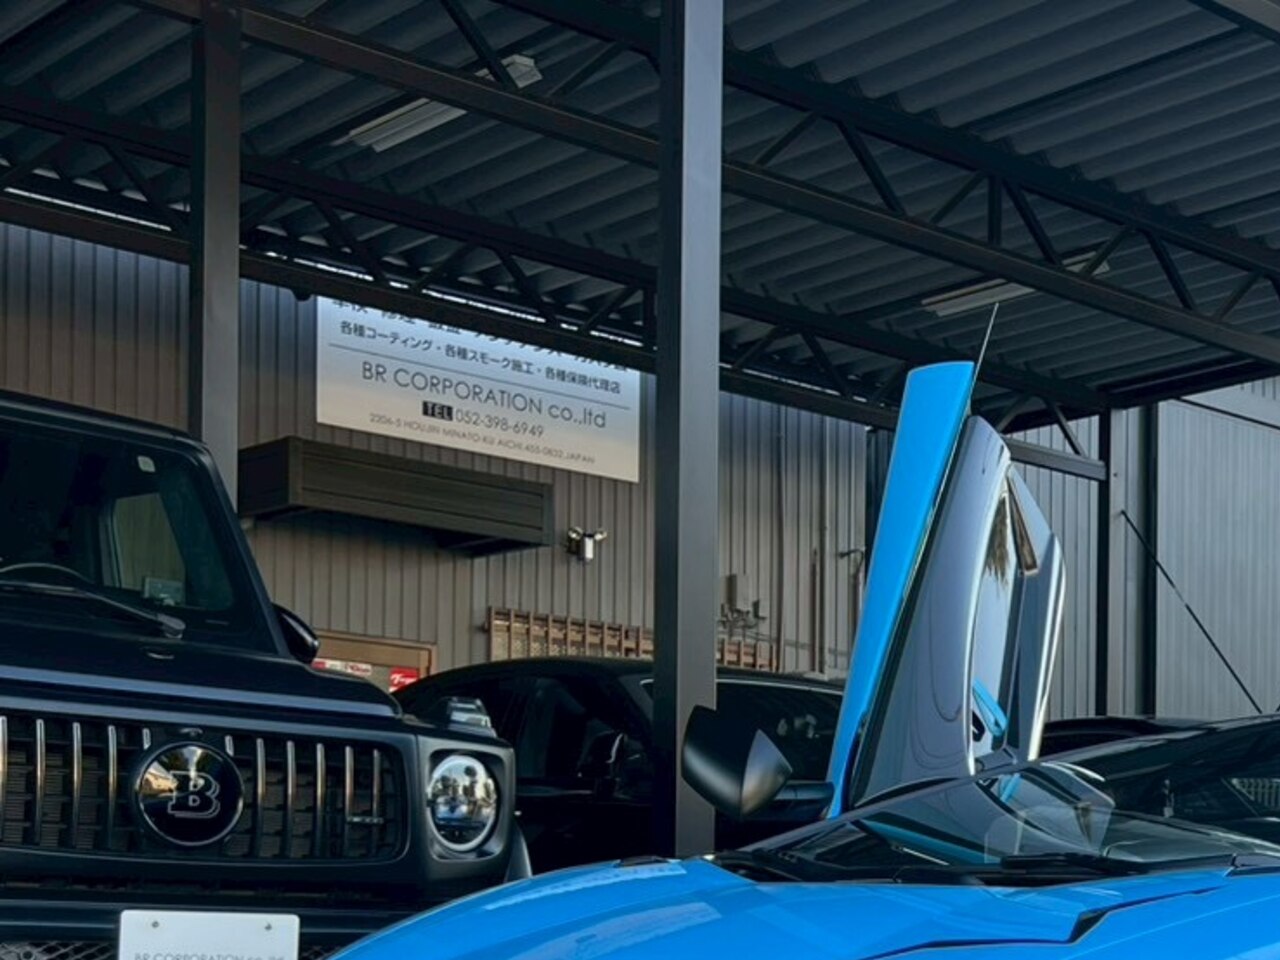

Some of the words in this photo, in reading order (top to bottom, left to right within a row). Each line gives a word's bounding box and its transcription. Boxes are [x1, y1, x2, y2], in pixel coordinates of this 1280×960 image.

[362, 361, 387, 383] BR
[393, 367, 542, 414] CORPORATION
[424, 402, 453, 421] TEL
[455, 408, 544, 438] 052-398-6949
